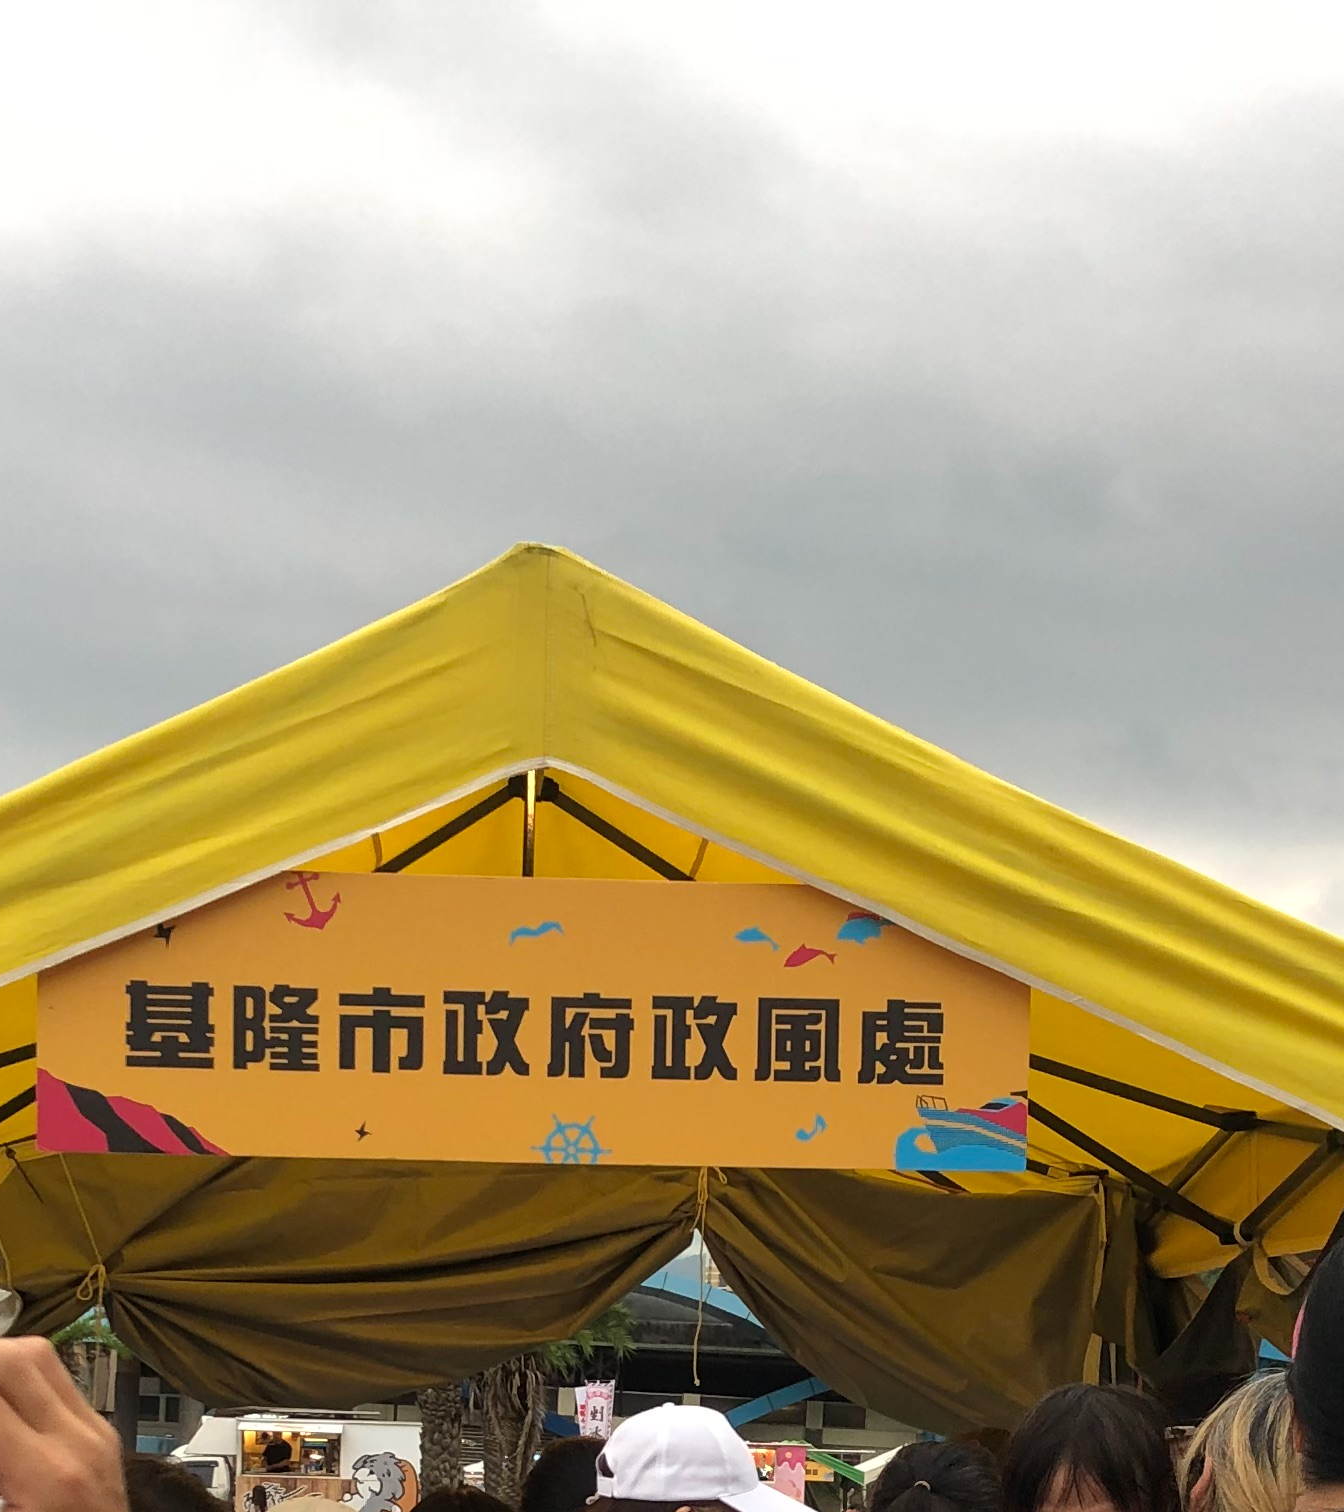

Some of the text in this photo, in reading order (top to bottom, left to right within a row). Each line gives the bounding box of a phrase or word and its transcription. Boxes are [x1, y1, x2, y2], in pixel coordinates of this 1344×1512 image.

[125, 979, 945, 1087] 基隆市政府政風處
